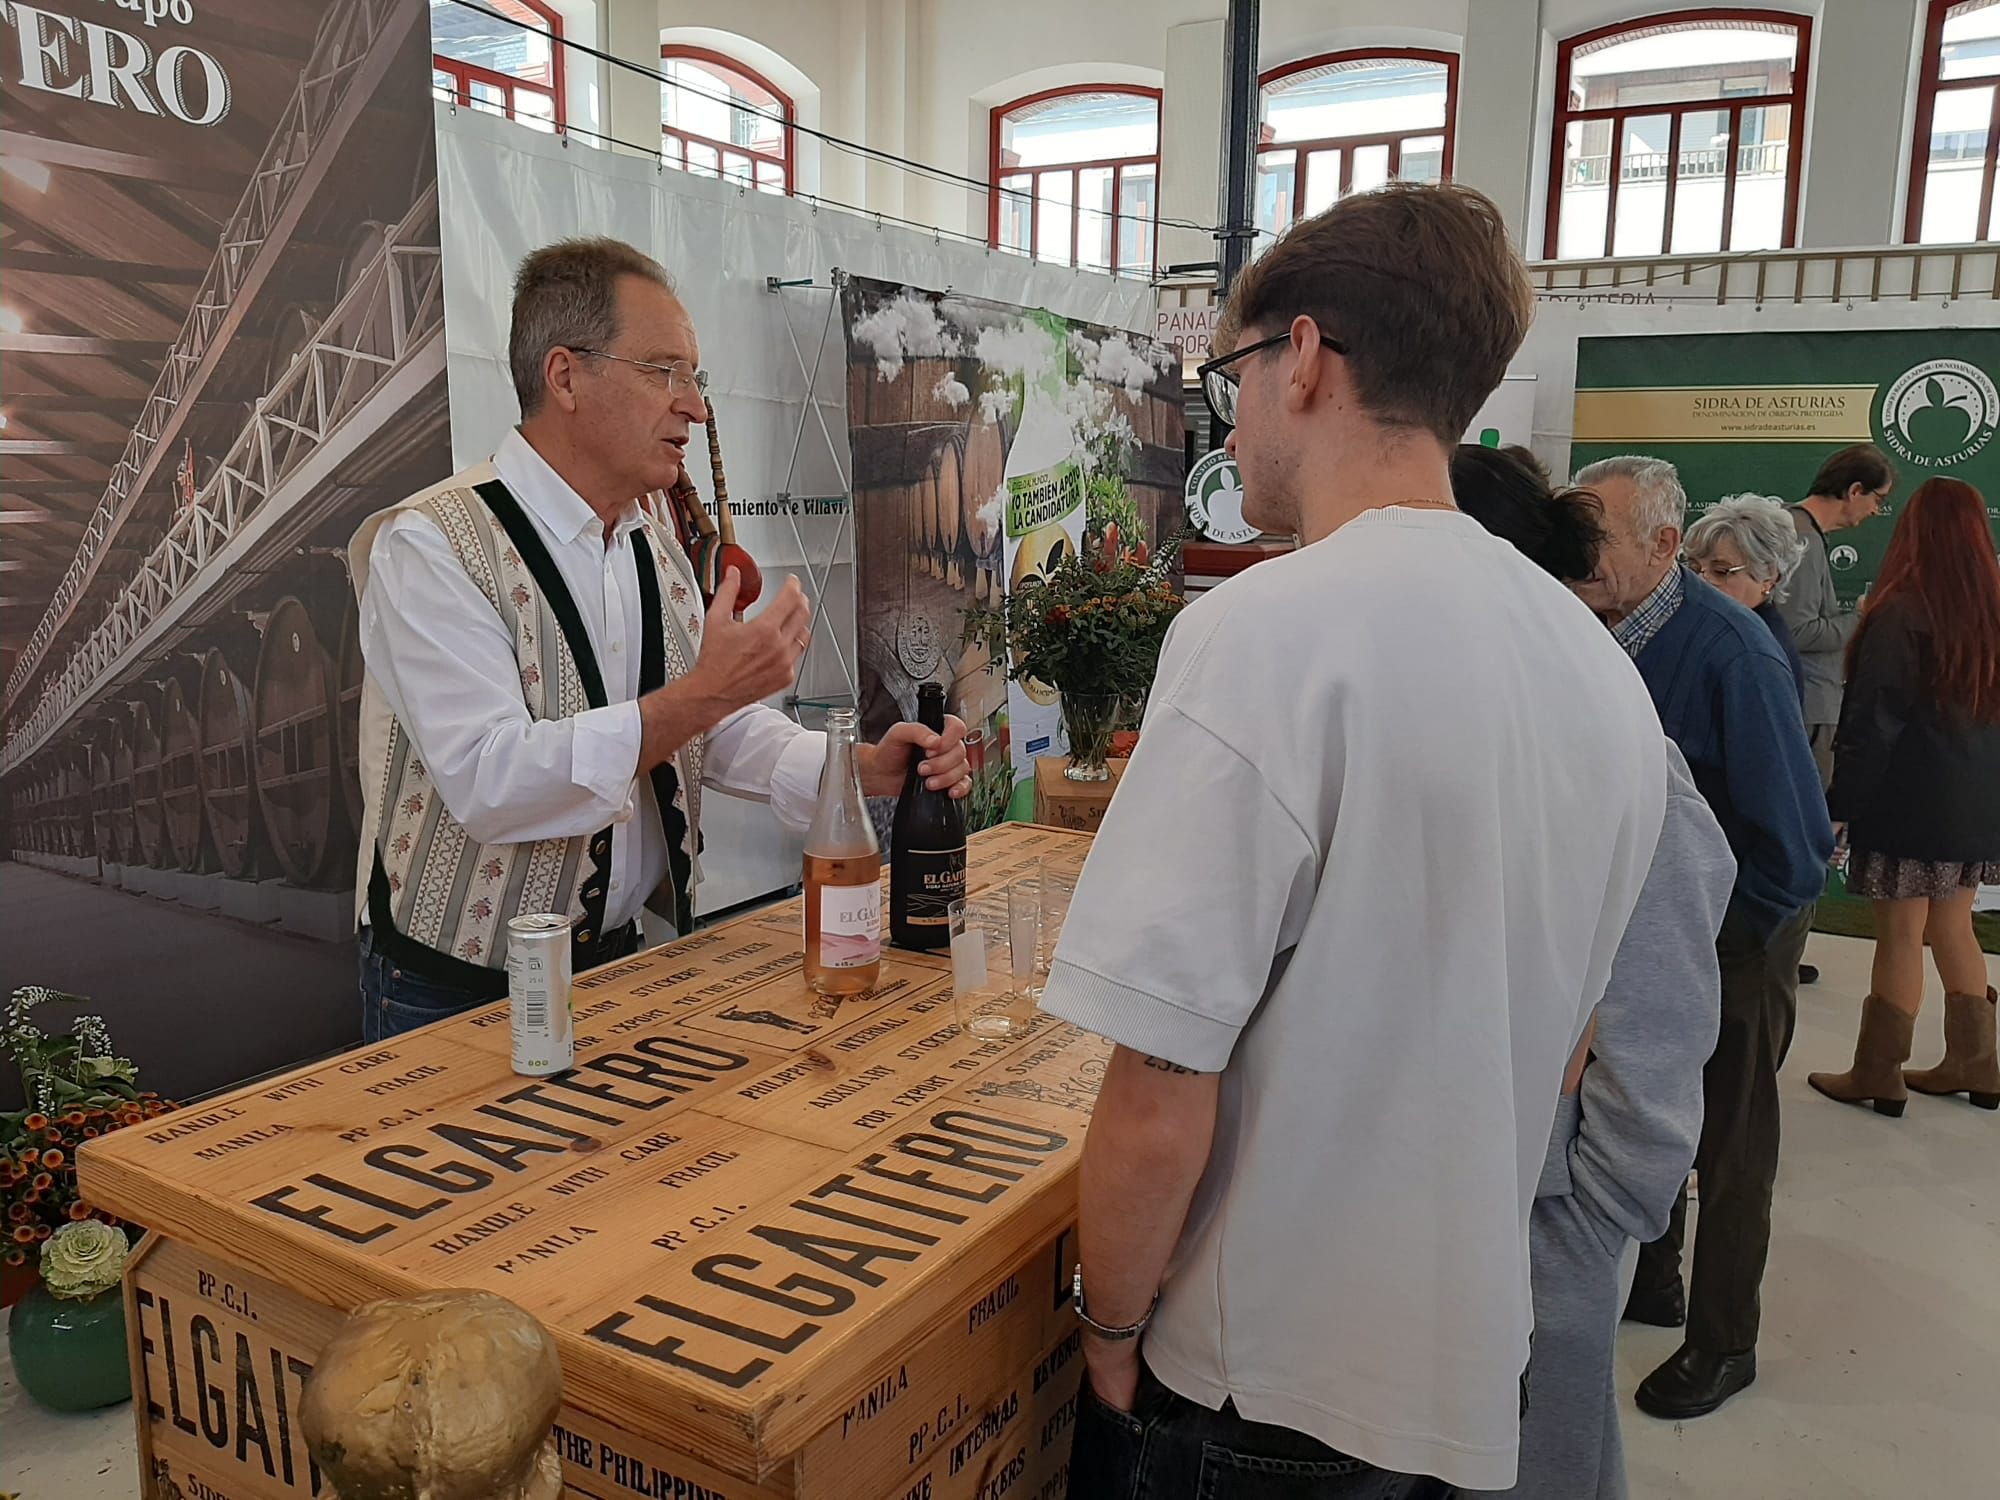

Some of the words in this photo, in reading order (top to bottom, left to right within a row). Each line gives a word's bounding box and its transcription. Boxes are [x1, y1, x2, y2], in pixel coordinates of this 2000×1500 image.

[1157, 310, 1217, 332] PANAD
[1693, 397, 1740, 410] SIDRA
[1746, 397, 1763, 409] DE
[1768, 396, 1845, 409] ASTURIAS
[1883, 429, 1912, 461] SIDRA
[1914, 454, 1932, 466] DE
[1934, 430, 1993, 467] ASTURIAS
[1012, 494, 1021, 511] YO
[1022, 481, 1058, 508] TAMBIEN
[1059, 465, 1081, 495] APOYO
[1014, 512, 1024, 530] LA
[1024, 484, 1080, 527] CANDIDATURA
[1228, 526, 1256, 540] ASTU
[573, 961, 655, 990] INTERNAL
[629, 966, 706, 998] STICKERS
[572, 1035, 604, 1052] OR
[608, 1009, 671, 1035] EXPORT
[672, 993, 701, 1007] TO
[698, 980, 735, 997] THE
[738, 1051, 831, 1100] PHILIPPINE
[832, 1018, 909, 1053] INTERNAL
[808, 1064, 896, 1110] AUXILIARY
[897, 1022, 961, 1061] STICKERS
[144, 1106, 247, 1145] HANDLE
[262, 1077, 325, 1102] WITH
[339, 1050, 401, 1075] CARE
[852, 1109, 896, 1130] FOR
[892, 1075, 954, 1108] EXPORT
[949, 1058, 980, 1073] TO
[969, 1038, 1007, 1058] THE
[193, 1122, 296, 1161] MANILA
[430, 1202, 537, 1255] HANDLE
[547, 1166, 610, 1197] WITH
[620, 1131, 682, 1163] CARE
[841, 1364, 908, 1441] MANILA
[552, 1424, 593, 1470] THE
